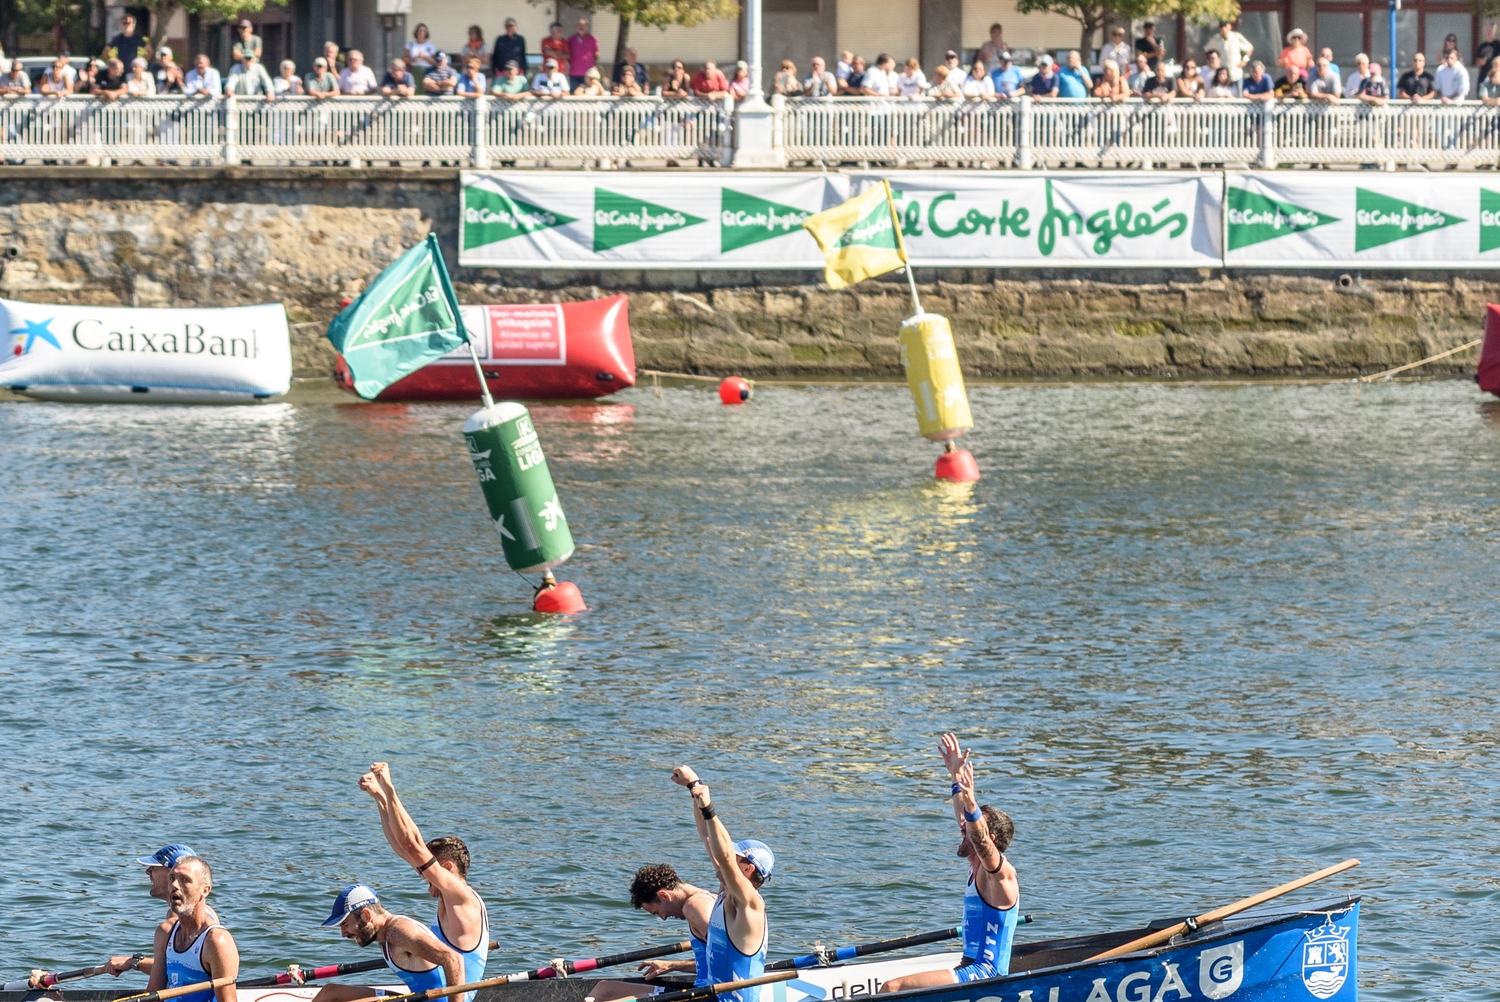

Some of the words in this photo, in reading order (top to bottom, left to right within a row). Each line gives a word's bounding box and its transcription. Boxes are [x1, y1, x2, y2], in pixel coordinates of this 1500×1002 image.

[767, 207, 806, 231] Inglé
[928, 193, 1031, 237] Corte
[1037, 179, 1189, 256] Inglés
